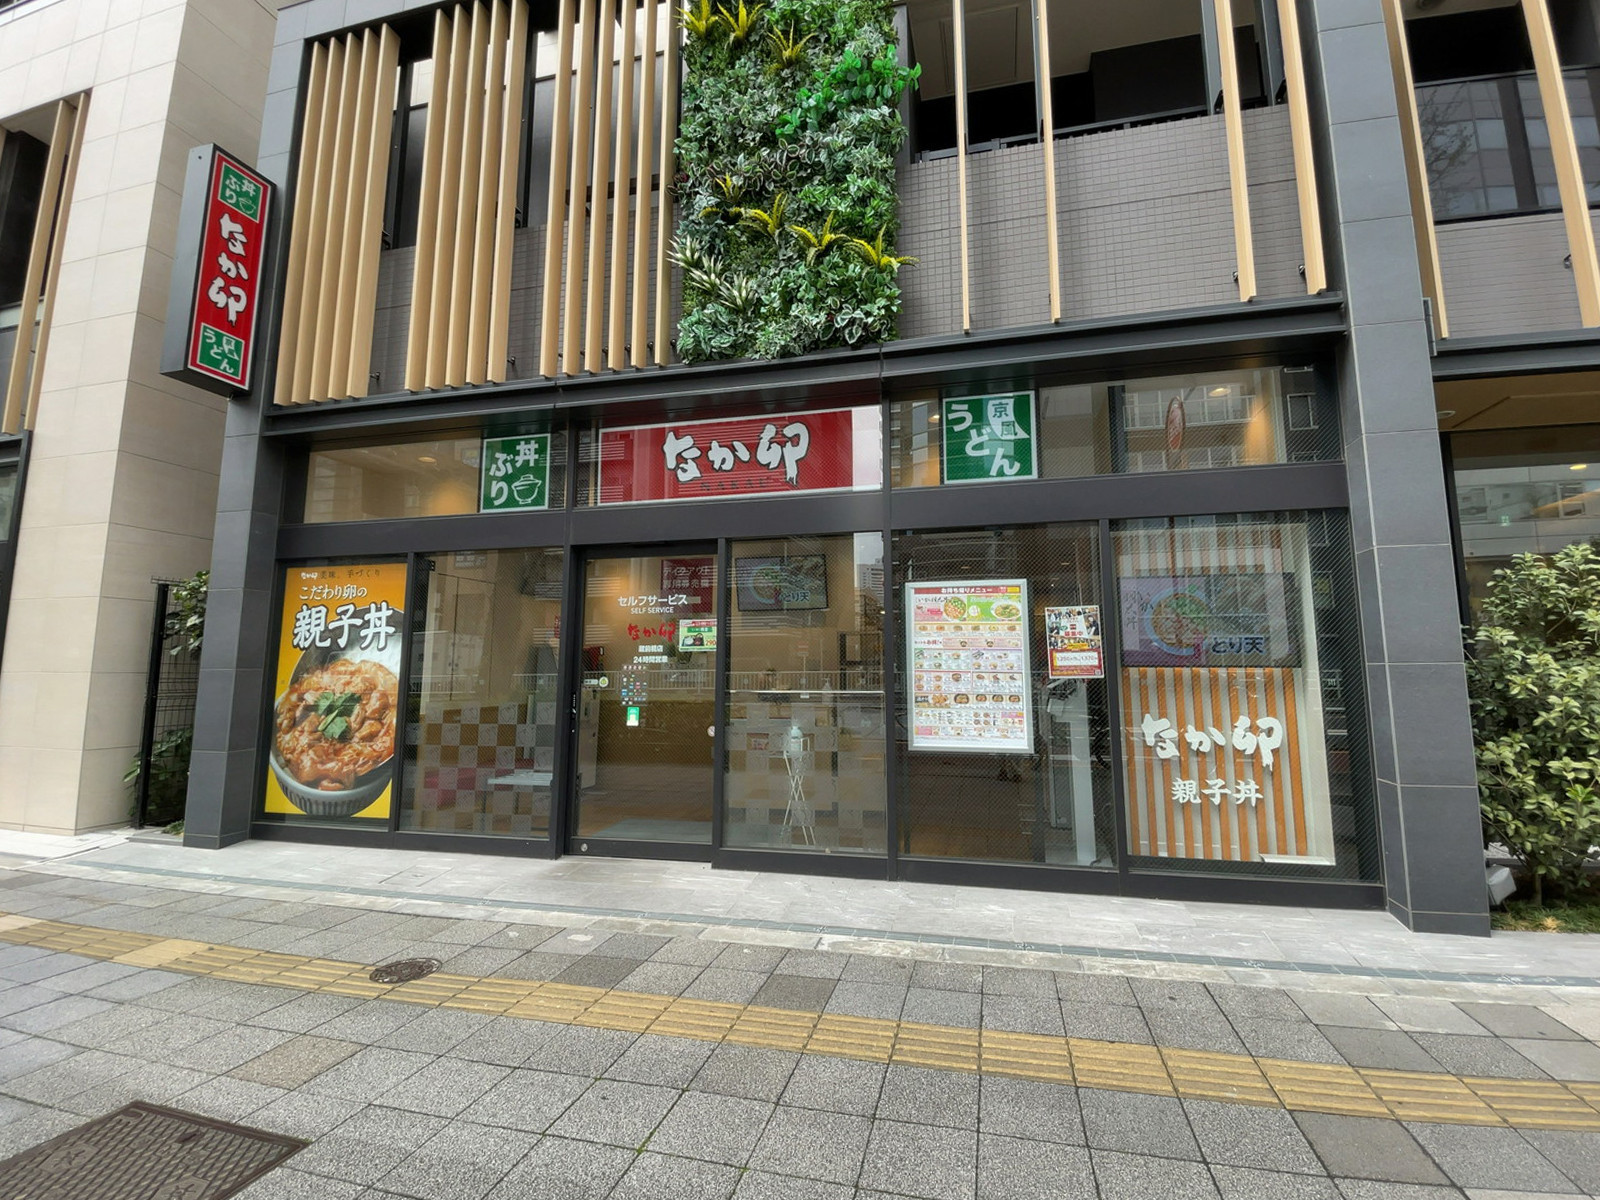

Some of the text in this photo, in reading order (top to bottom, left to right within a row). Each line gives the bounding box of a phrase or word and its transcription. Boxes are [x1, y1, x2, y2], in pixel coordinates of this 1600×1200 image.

[208, 213, 249, 327] なか卯
[204, 329, 234, 374] うどん
[992, 402, 1019, 437] 京風
[663, 421, 810, 487] なか卯
[948, 403, 1021, 477] うどん
[299, 584, 368, 600] こだわり卵の
[617, 593, 688, 607] セルフサービス
[292, 601, 396, 650] 親子丼
[648, 606, 674, 614] SERVICE
[627, 621, 677, 642] なか卯
[1211, 636, 1265, 654] とり天
[1141, 713, 1284, 771] なか卯
[1172, 777, 1264, 808] 親子丼
